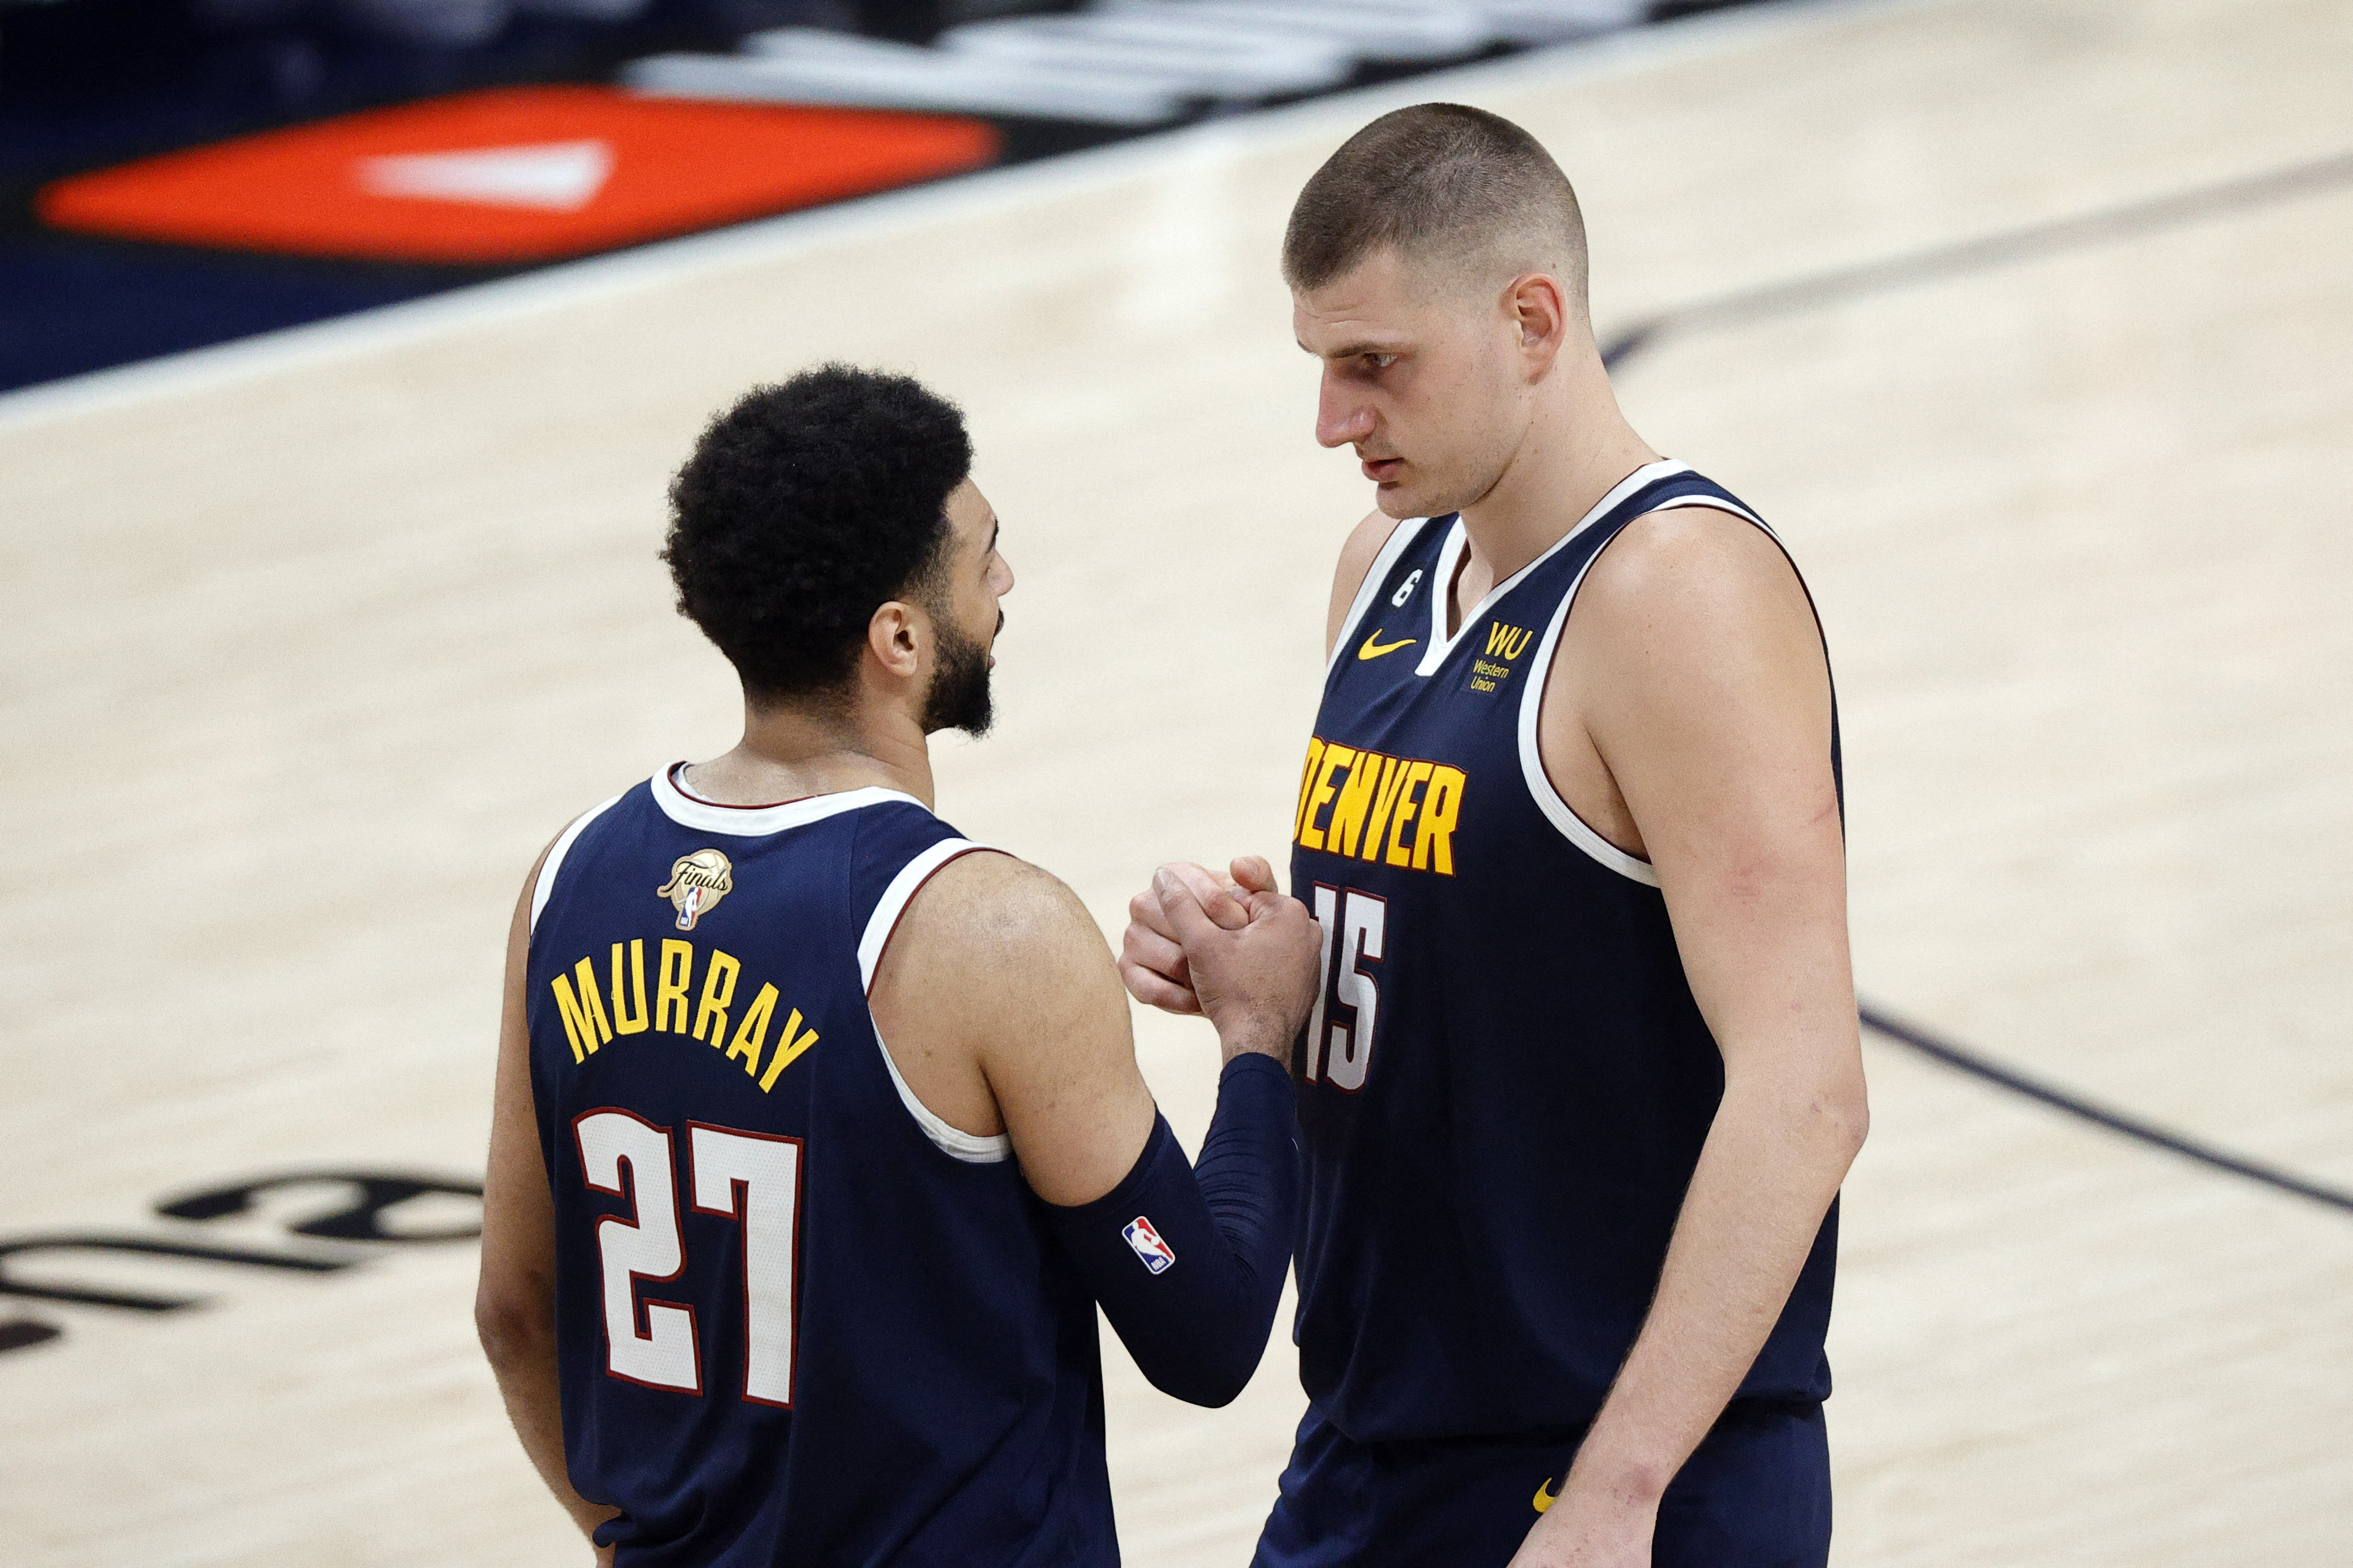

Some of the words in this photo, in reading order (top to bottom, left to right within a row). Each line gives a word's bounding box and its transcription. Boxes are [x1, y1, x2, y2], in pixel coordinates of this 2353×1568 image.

[1392, 569, 1423, 608] 6
[1485, 621, 1534, 660] WU
[1471, 675, 1496, 693] Union
[1473, 659, 1510, 679] Western
[1293, 735, 1469, 878] DENVER
[660, 860, 728, 893] Finals
[1305, 880, 1387, 1094] 15
[551, 938, 819, 1094] MURRAY
[571, 1106, 804, 1410] 27
[1151, 1256, 1166, 1270] NBA
